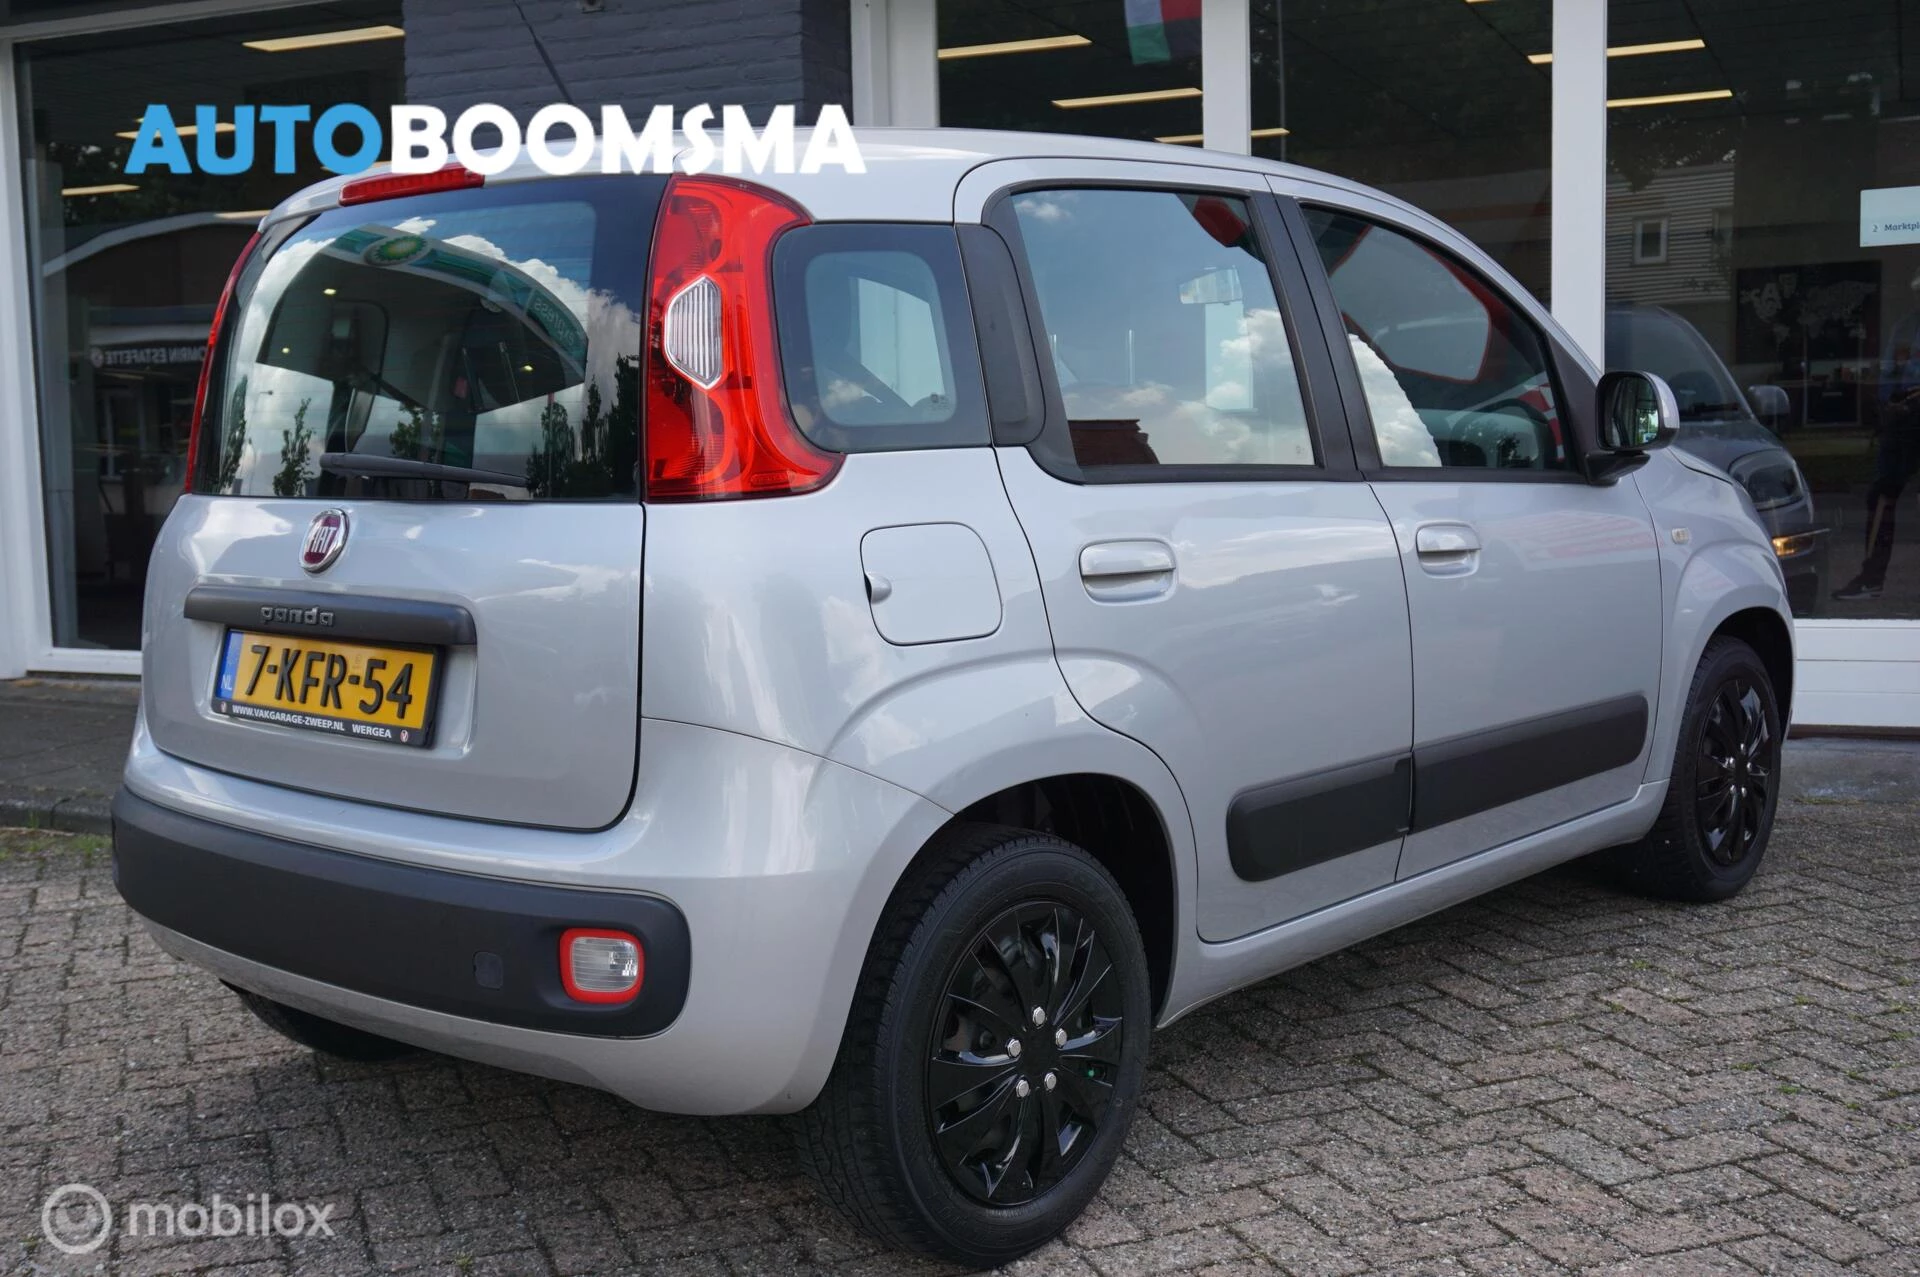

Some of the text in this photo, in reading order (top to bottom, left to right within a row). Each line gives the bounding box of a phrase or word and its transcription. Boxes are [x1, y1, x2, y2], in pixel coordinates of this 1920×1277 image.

[1885, 221, 1920, 231] Marktpl
[306, 526, 337, 553] FIAT
[261, 606, 334, 626] panda
[221, 674, 233, 691] NL
[245, 645, 413, 719] 7-KFR-54
[232, 704, 392, 738] WWW.VAKGARAGE-ZWEEP.NL WERGEA
